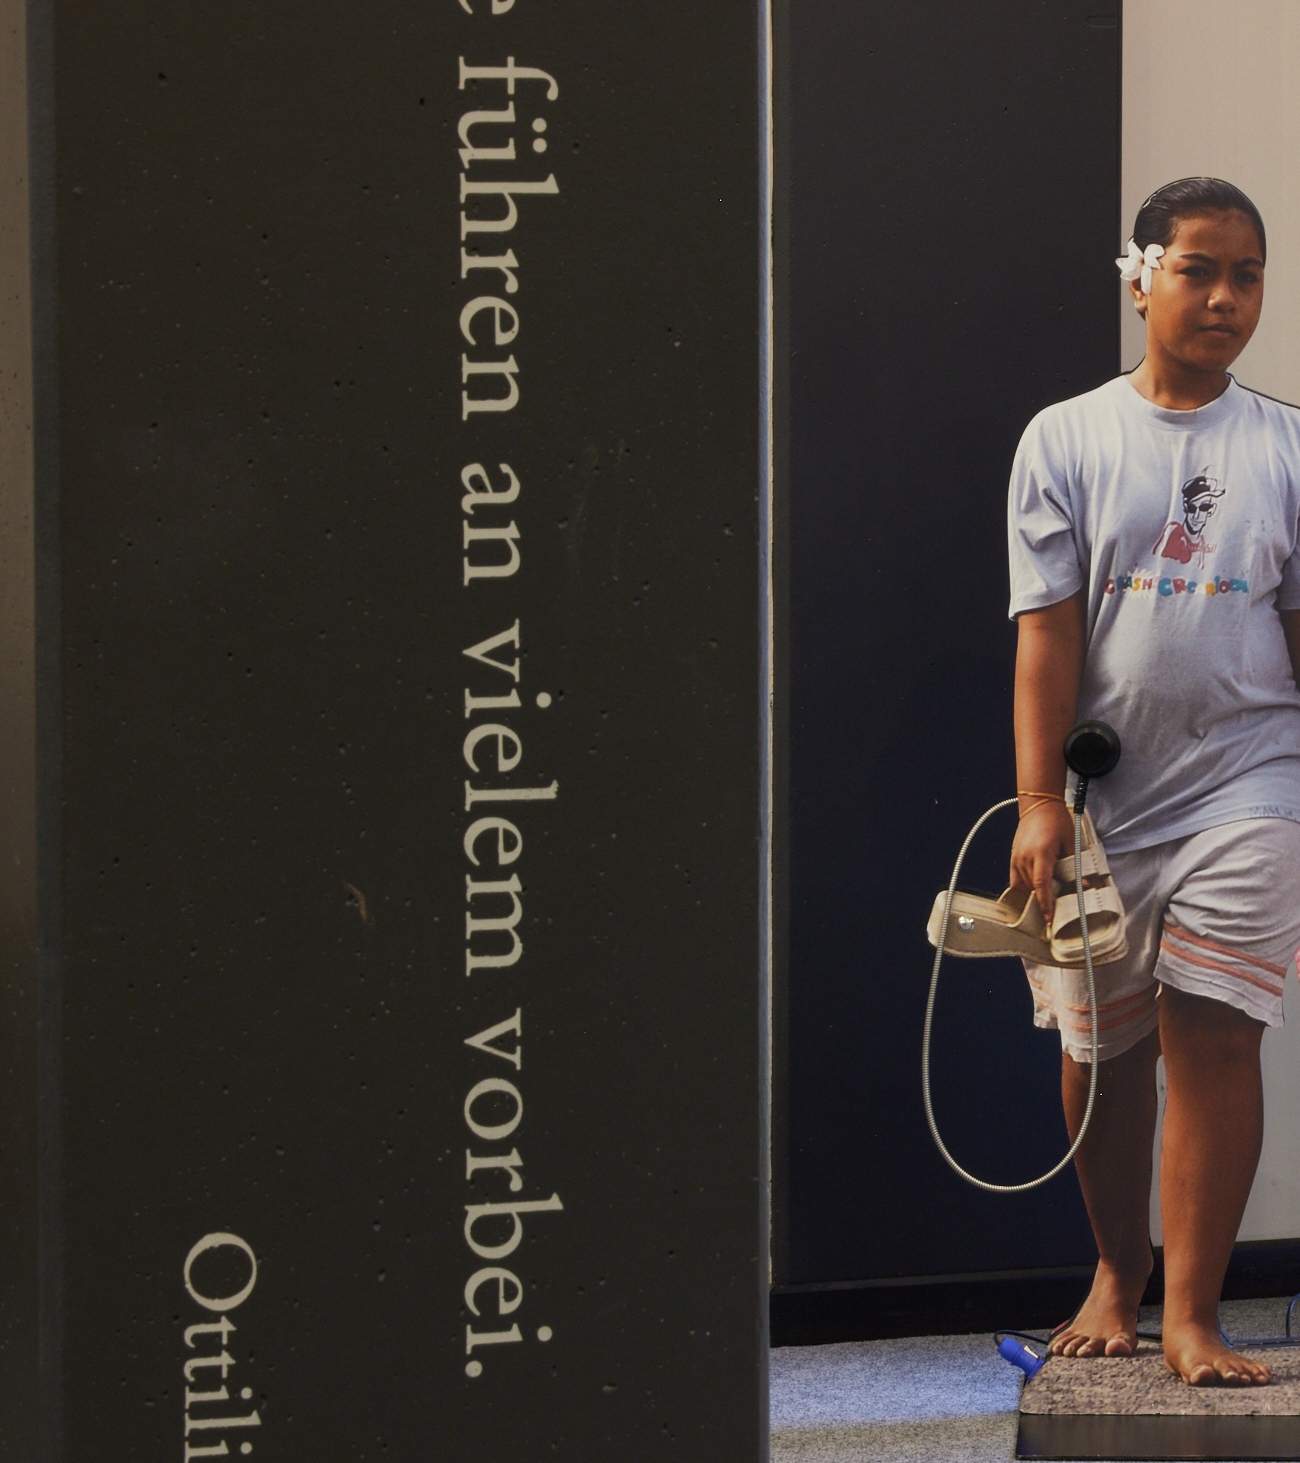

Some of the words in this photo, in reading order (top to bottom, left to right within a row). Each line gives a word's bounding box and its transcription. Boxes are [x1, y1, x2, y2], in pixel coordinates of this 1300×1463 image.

[458, 56, 559, 420] führen
[461, 463, 520, 585] an
[463, 619, 558, 976] vielem
[184, 1233, 260, 1463] Ottili
[464, 1008, 563, 1377] vorbei.
